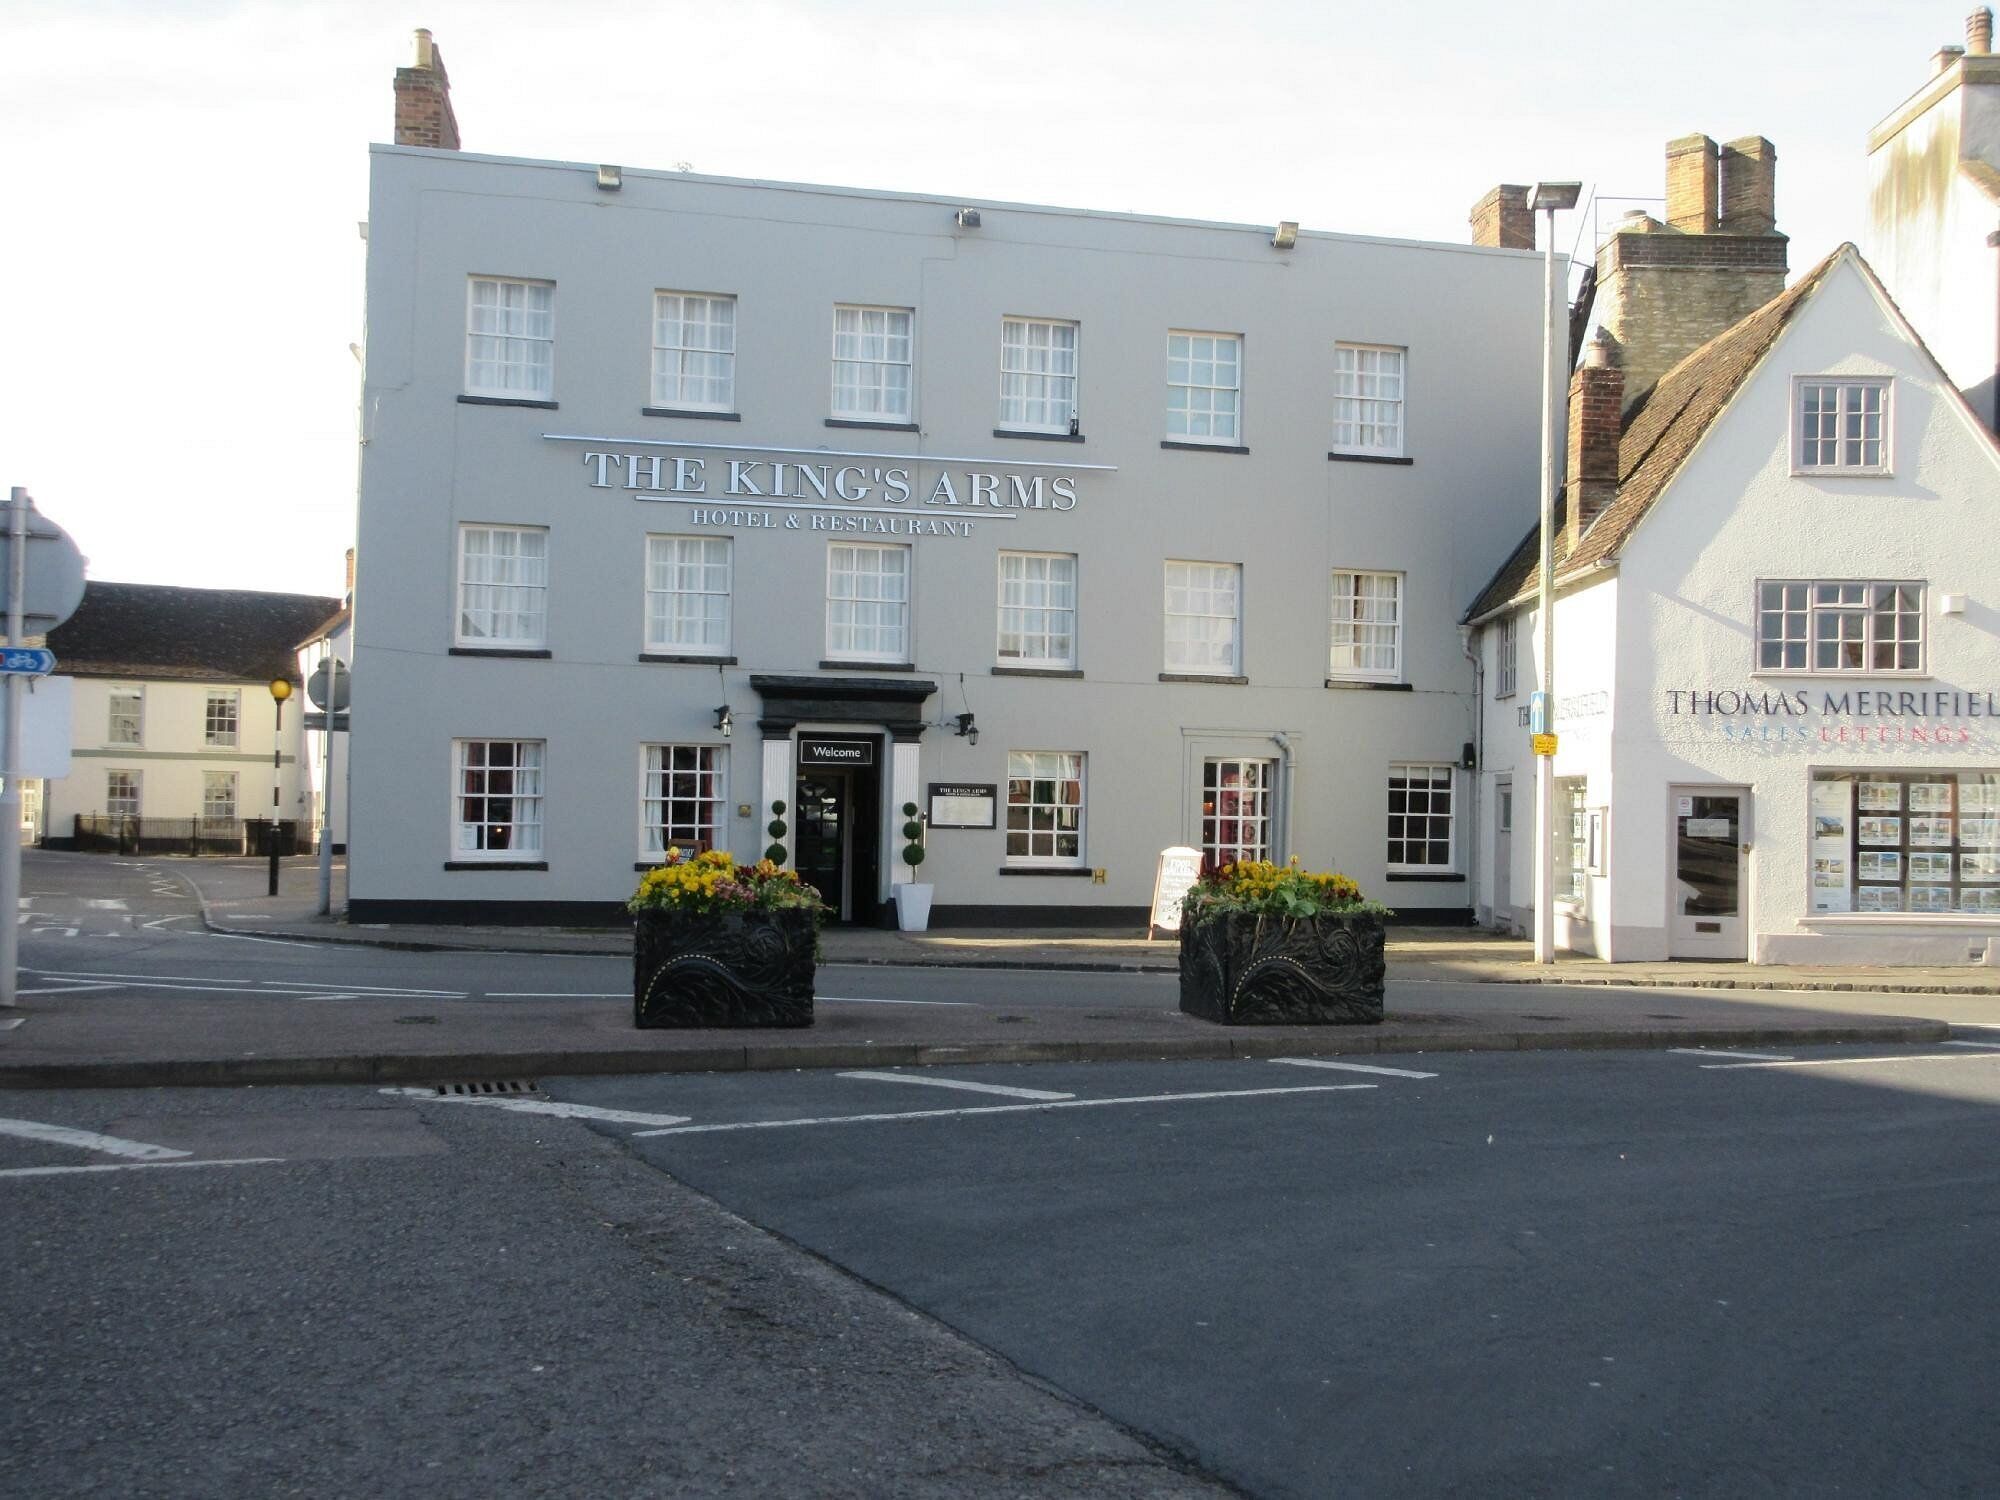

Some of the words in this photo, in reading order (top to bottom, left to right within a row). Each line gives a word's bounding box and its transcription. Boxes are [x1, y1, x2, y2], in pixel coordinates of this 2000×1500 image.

[584, 452, 706, 493] THE
[723, 460, 912, 503] KING'S
[925, 471, 1077, 511] ARMS
[691, 509, 778, 529] HOTEL
[785, 513, 801, 530] &
[810, 515, 976, 538] RESTAURANT
[1667, 690, 1808, 716] THOMAS
[1724, 726, 1807, 742] SALES
[1818, 726, 1969, 744] LETTINGS
[813, 746, 861, 757] Welcome
